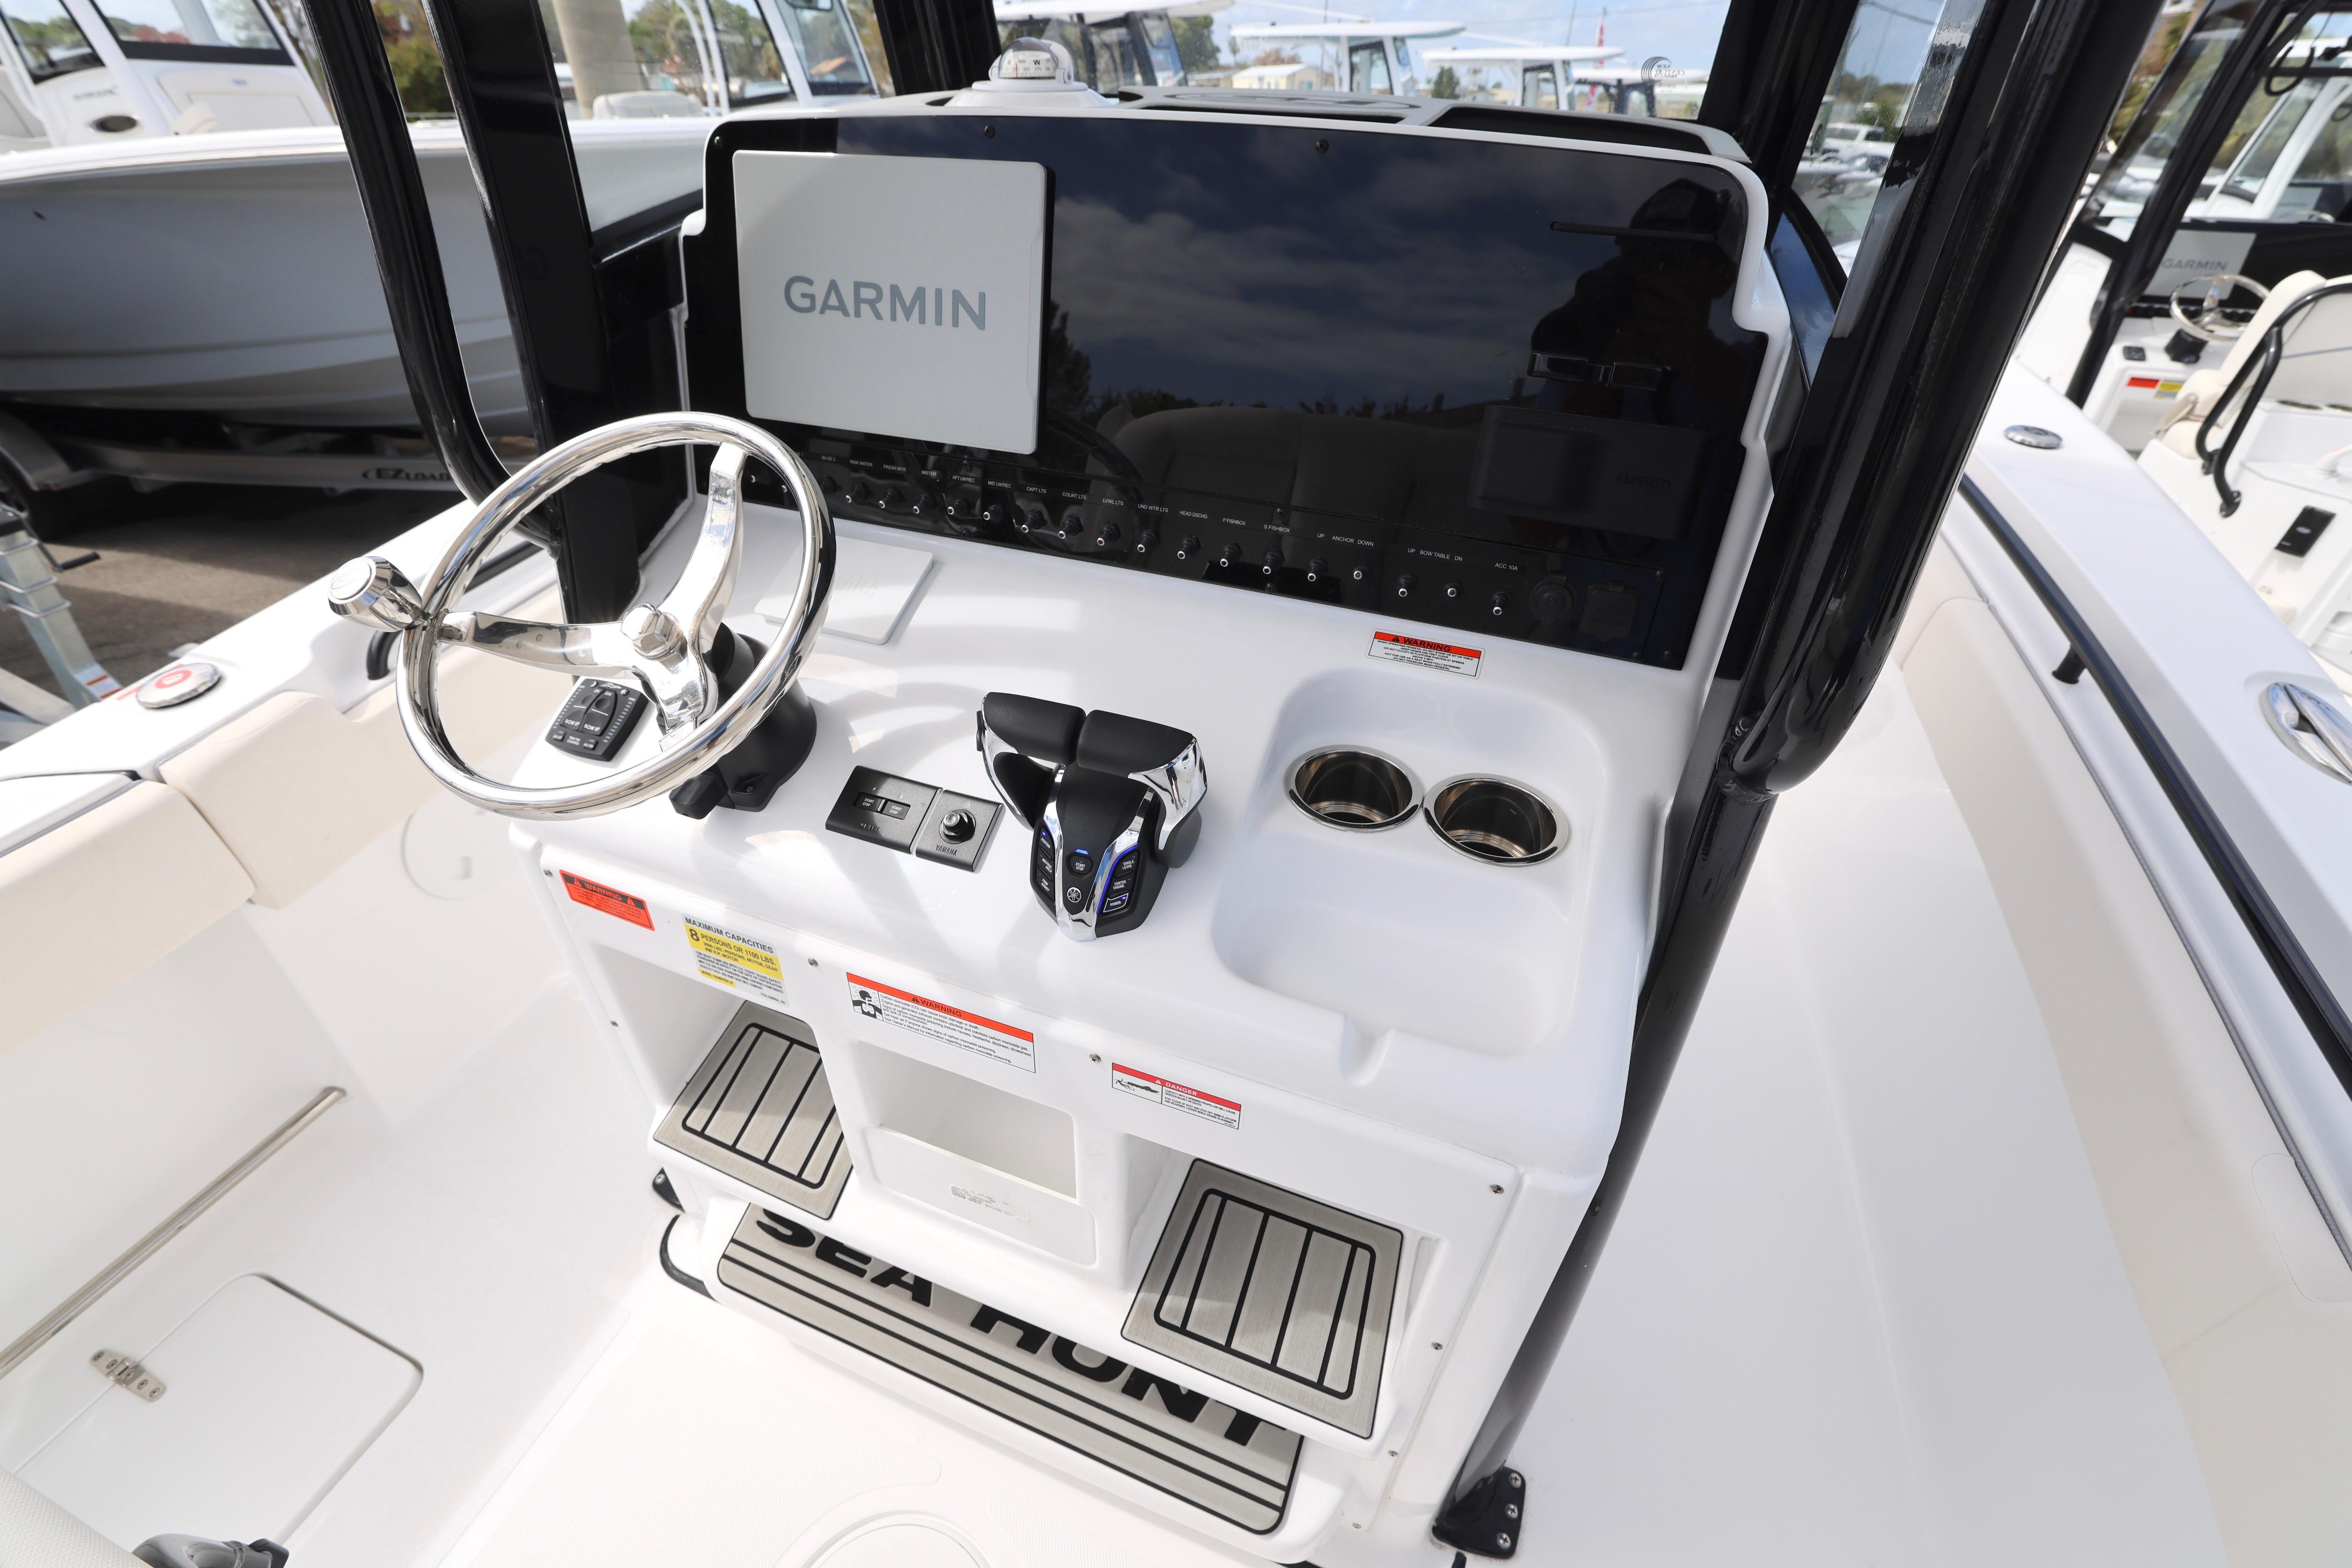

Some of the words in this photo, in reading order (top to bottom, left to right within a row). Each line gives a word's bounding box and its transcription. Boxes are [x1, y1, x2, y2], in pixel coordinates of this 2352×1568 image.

[2161, 259, 2228, 271] GARMIN
[784, 275, 986, 330] GARMIN
[1402, 637, 1451, 651] WARNING
[936, 844, 957, 856] YAMAHA
[1041, 838, 1051, 848] STATION
[1042, 858, 1052, 869] NEUTRAL
[584, 882, 622, 901] WARNING
[1041, 882, 1050, 892] ASSIST
[685, 917, 723, 936] MAXIMUM
[725, 931, 773, 954] CAPACITIES
[688, 928, 700, 942] 8
[700, 933, 732, 949] PERSONS
[733, 945, 743, 954] OR
[745, 949, 759, 959] 1100
[760, 954, 776, 965] LBS.
[893, 998, 910, 1007] monoxide
[948, 1016, 963, 1025] damage
[921, 999, 961, 1017] WARNING
[901, 1006, 917, 1015] generator
[972, 1029, 987, 1038] colorless
[1002, 1039, 1020, 1048] monoxide
[925, 1030, 945, 1040] information
[945, 1038, 961, 1046] regarding
[975, 1048, 992, 1056] monoxide
[926, 1019, 943, 1028] poisoning
[972, 1034, 991, 1043] headache,
[991, 1041, 1009, 1049] dizziness,
[1010, 1047, 1031, 1057] drowsiness
[960, 1038, 977, 1046] monoxide
[1165, 1082, 1197, 1096] DANGER
